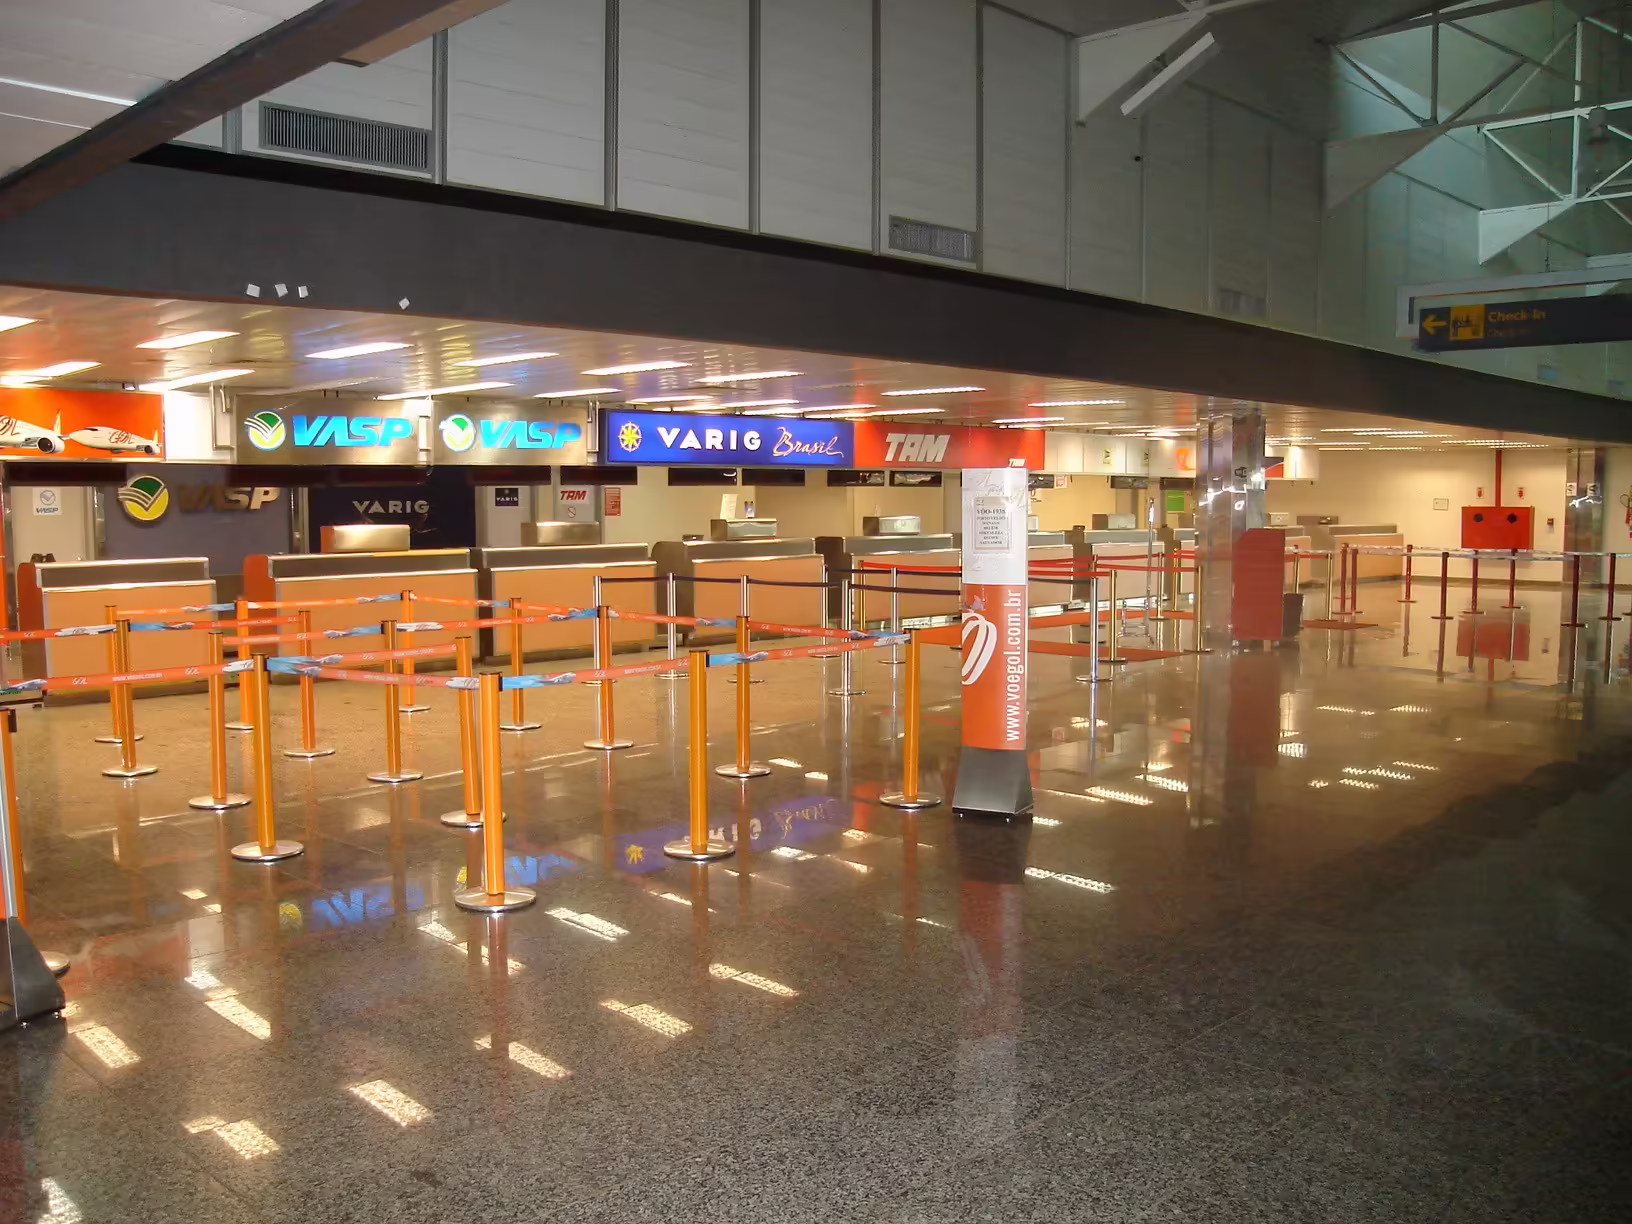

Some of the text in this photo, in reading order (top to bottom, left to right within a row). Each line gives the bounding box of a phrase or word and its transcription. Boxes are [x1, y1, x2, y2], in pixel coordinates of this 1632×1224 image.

[292, 415, 413, 448] VASP
[480, 419, 582, 449] VASP
[657, 426, 845, 458] VARIG Brasil
[884, 432, 951, 463] TAM
[352, 500, 430, 514] VARIG
[560, 490, 587, 501] TAM
[1003, 589, 1024, 741] www.voegol.com.br
